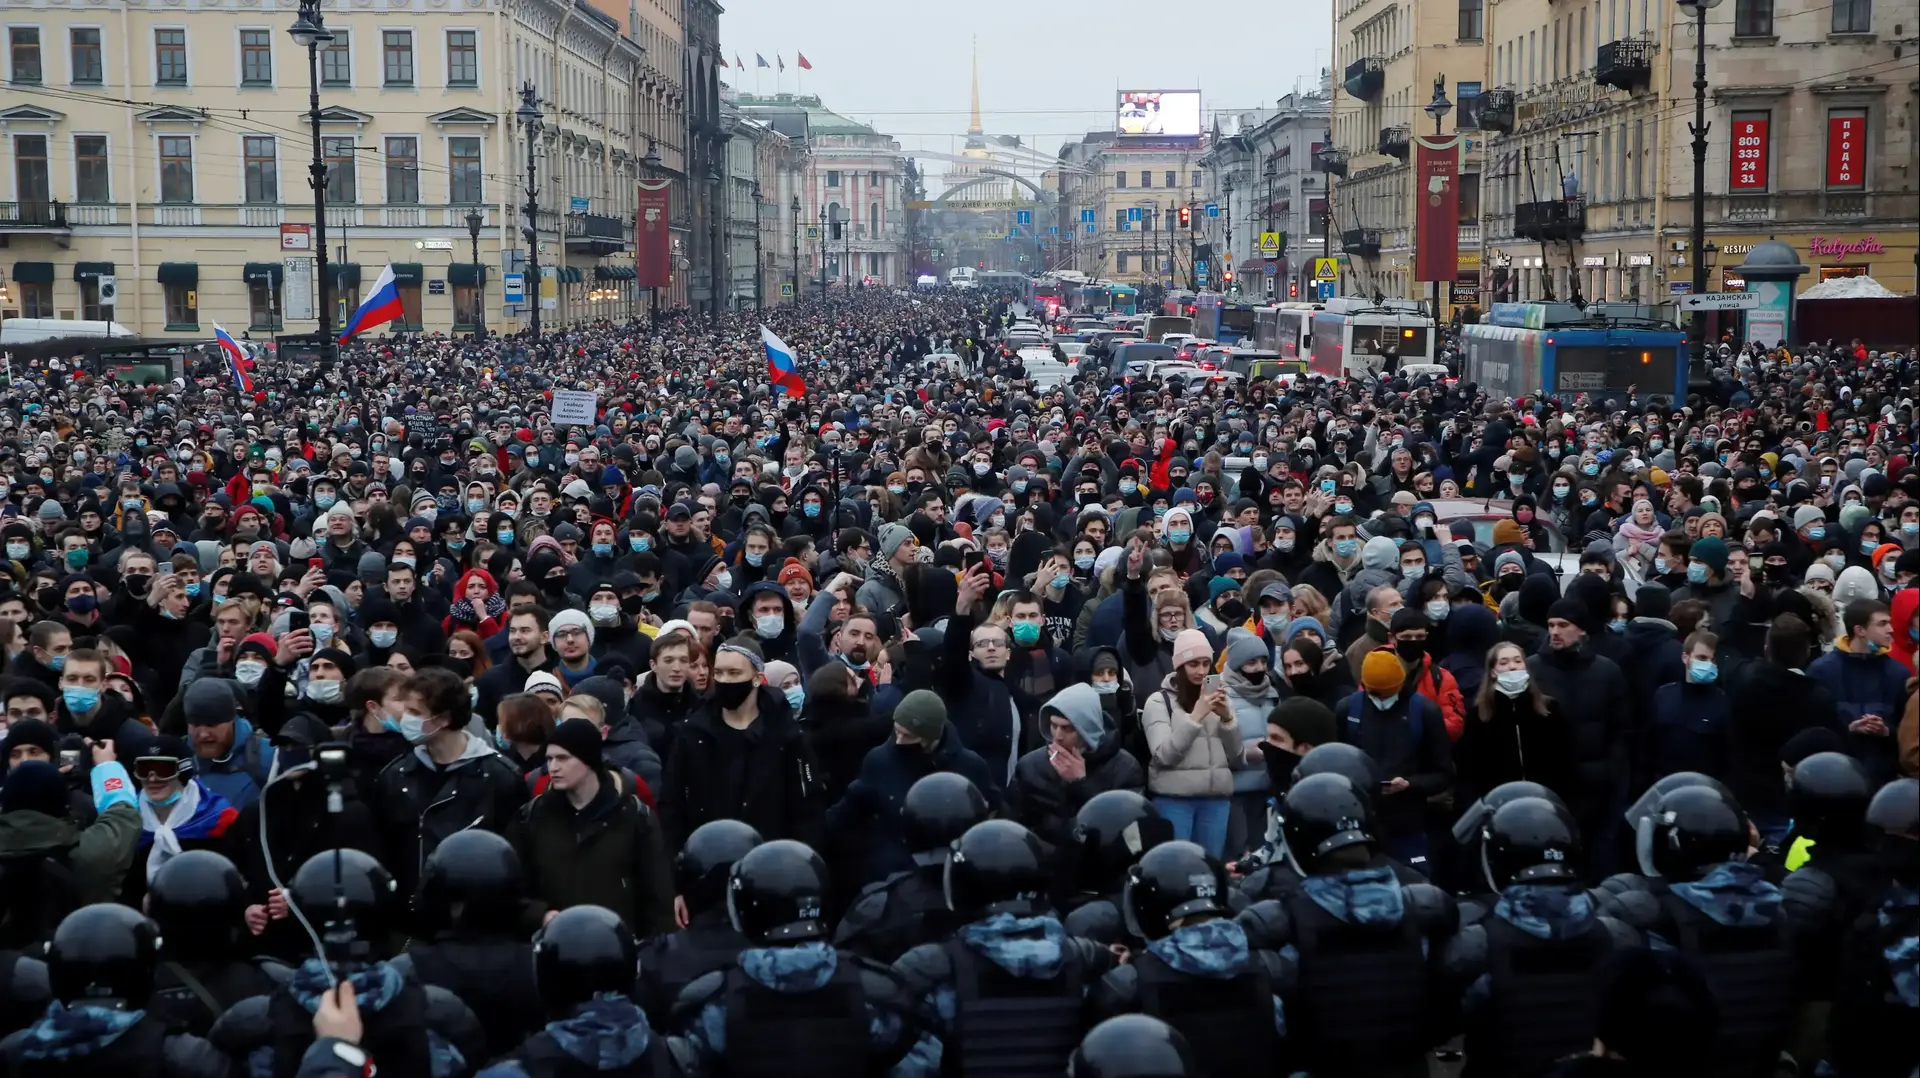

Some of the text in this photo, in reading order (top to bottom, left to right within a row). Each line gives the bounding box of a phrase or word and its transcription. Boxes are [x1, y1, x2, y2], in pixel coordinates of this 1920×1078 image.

[1746, 124, 1754, 133] 8
[1738, 136, 1760, 146] 800
[1738, 149, 1760, 158] 333
[1840, 121, 1851, 181] ПРОДАЮ
[1741, 162, 1756, 171] 24
[1741, 174, 1755, 183] 31
[1723, 244, 1756, 254] RESTAU
[1808, 236, 1886, 262] Katyusha
